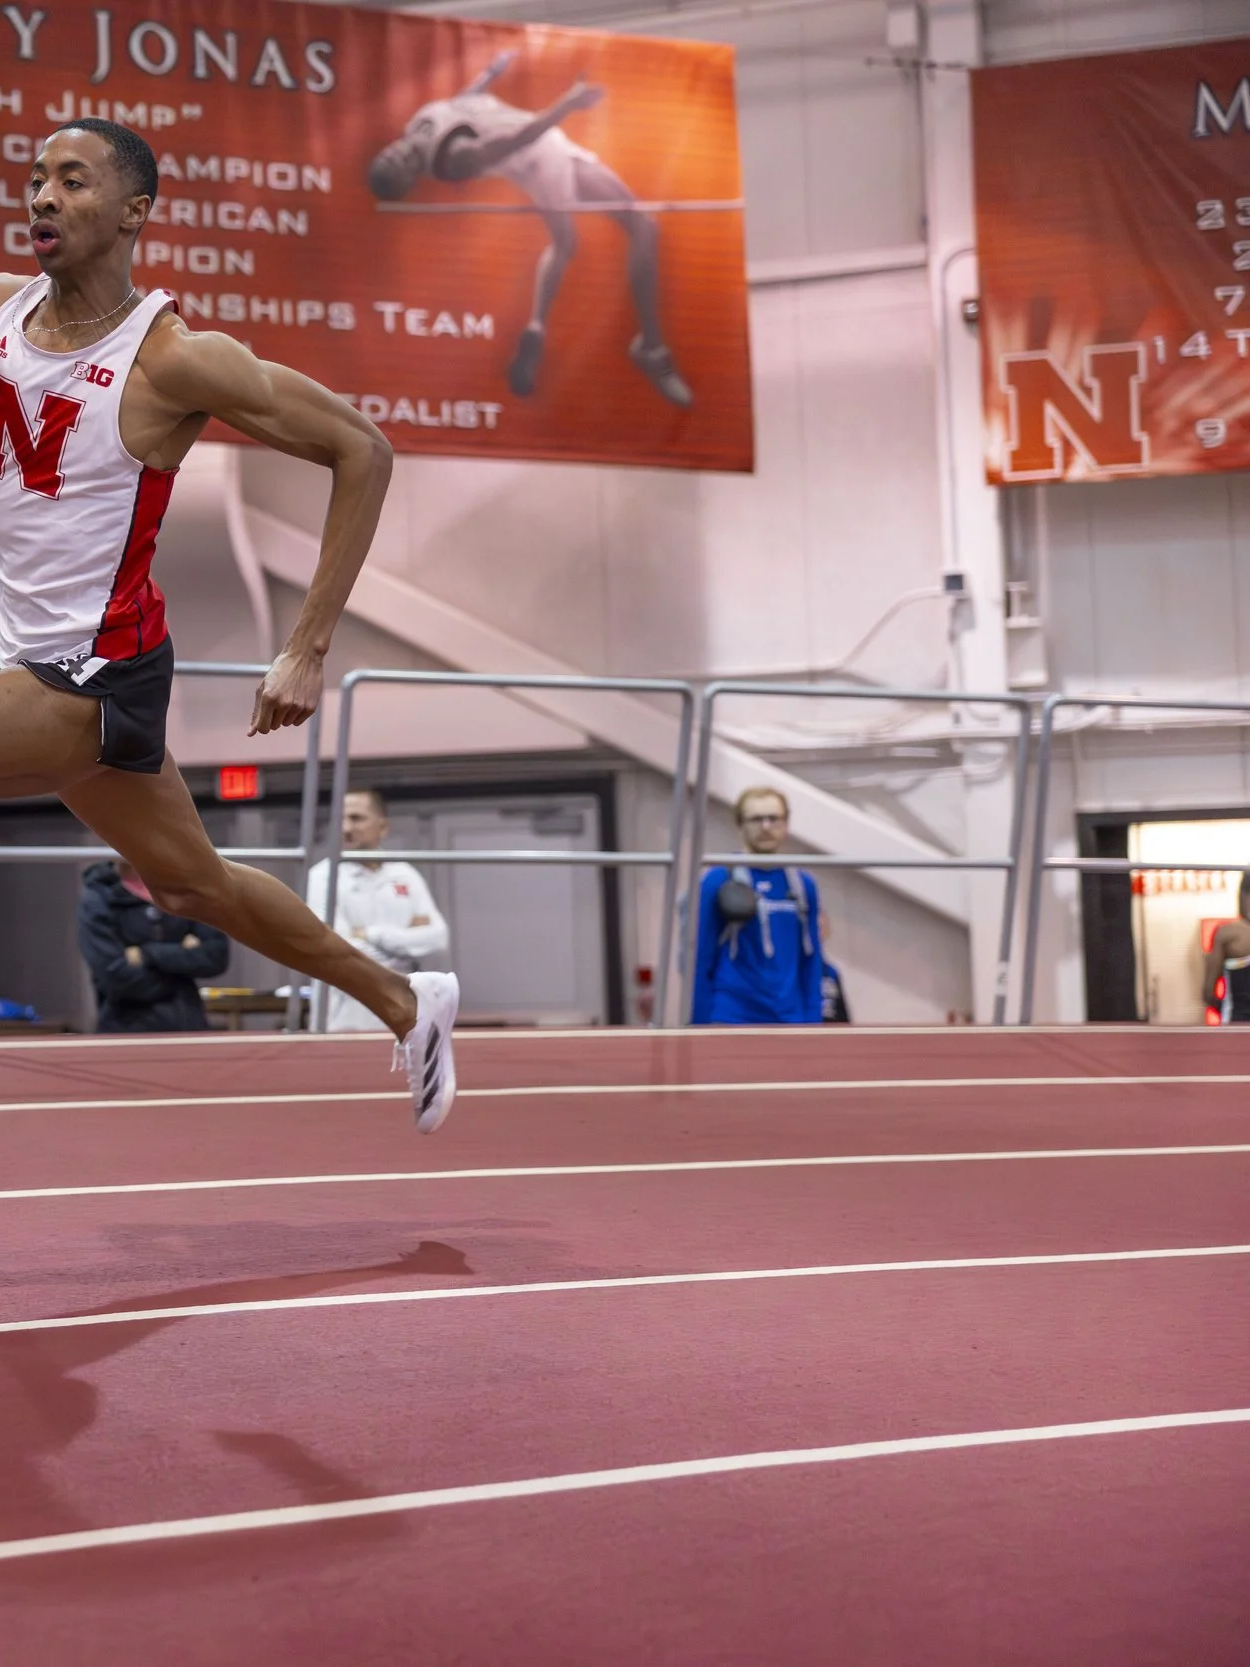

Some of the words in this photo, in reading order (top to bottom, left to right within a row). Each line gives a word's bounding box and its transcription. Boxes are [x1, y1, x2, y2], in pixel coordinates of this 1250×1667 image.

[90, 9, 337, 94] JONAS
[156, 152, 332, 194] AMPION
[372, 301, 495, 340] TEAM
[334, 392, 503, 430] DALIST
[998, 341, 1150, 483] N
